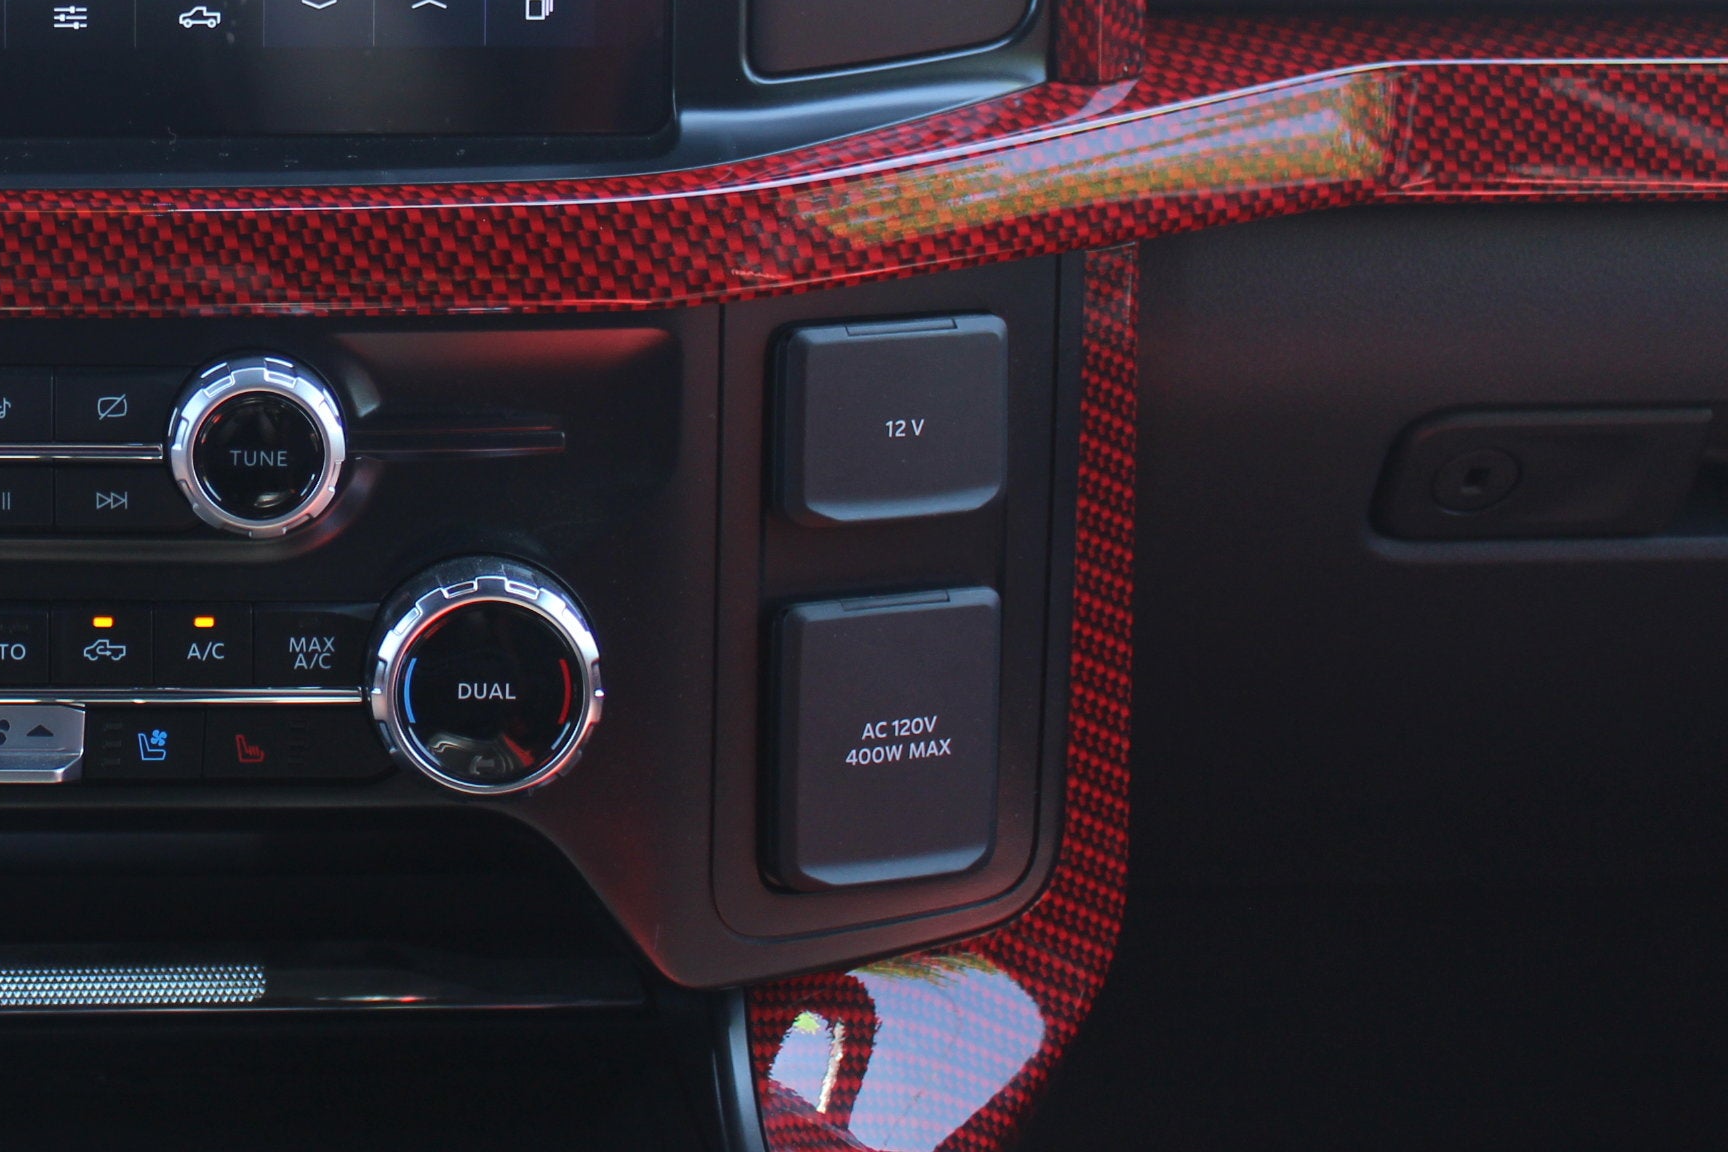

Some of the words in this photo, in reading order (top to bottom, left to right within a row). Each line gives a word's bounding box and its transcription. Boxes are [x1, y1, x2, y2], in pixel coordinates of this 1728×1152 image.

[886, 419, 906, 438] 12
[911, 418, 925, 436] V
[231, 450, 288, 467] TUNE
[187, 642, 225, 660] A/C
[289, 636, 335, 654] MAX
[294, 652, 332, 670] A/C
[457, 682, 516, 701] DUAL
[862, 722, 888, 741] AC
[892, 715, 938, 737] 120V
[845, 746, 904, 766] 400W
[908, 738, 952, 760] MAX
